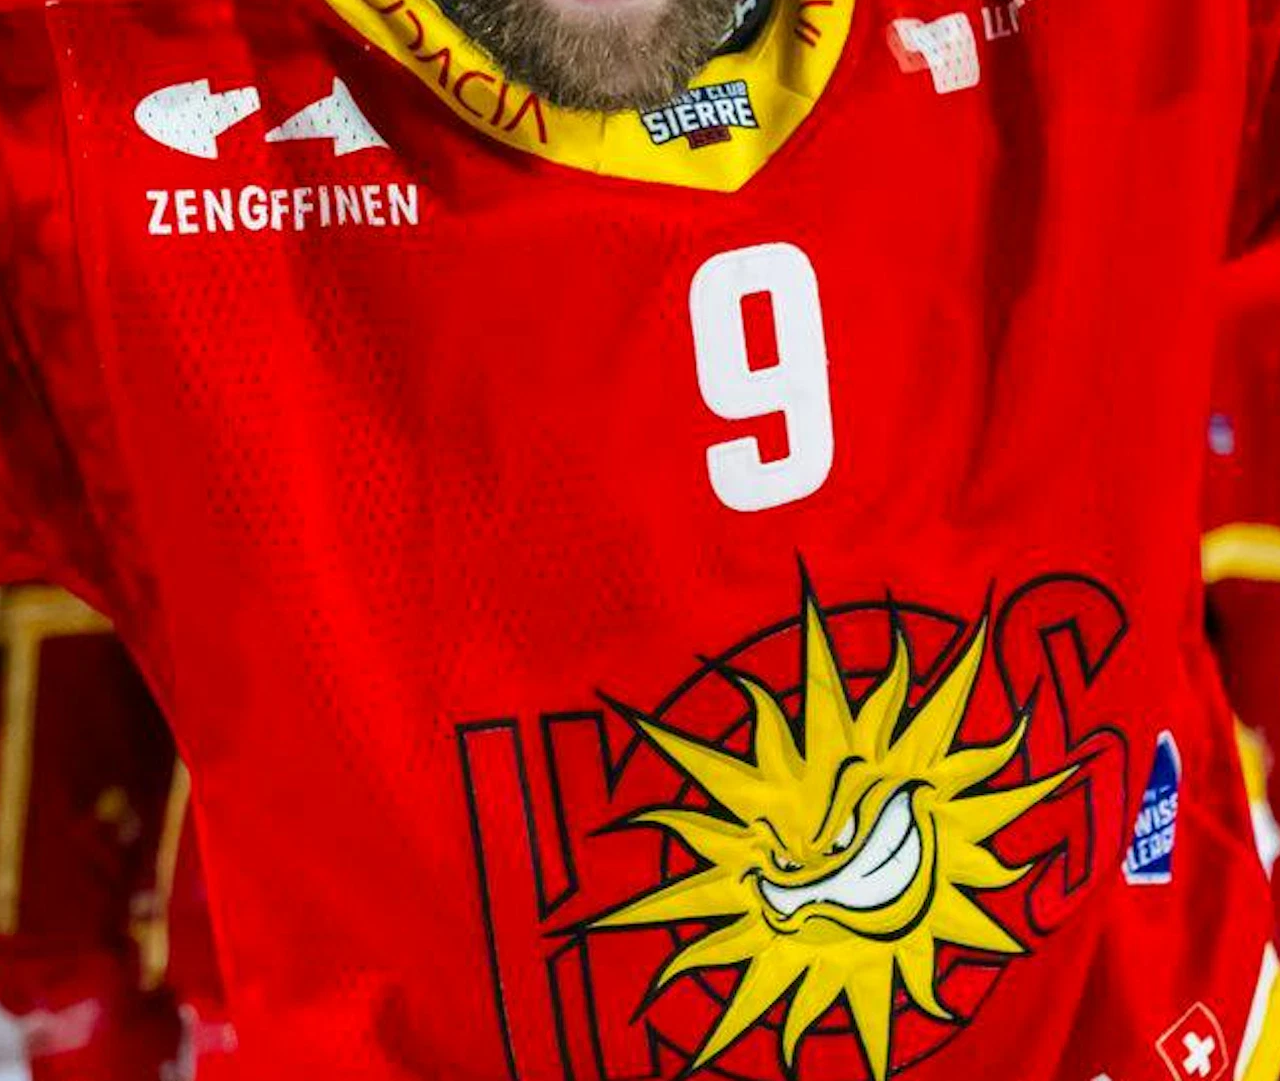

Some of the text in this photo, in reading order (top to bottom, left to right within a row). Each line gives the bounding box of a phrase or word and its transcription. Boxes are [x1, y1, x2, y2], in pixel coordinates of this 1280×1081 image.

[642, 98, 757, 144] SIERRE
[146, 183, 419, 235] ZENGFFINEN
[688, 241, 835, 513] 9
